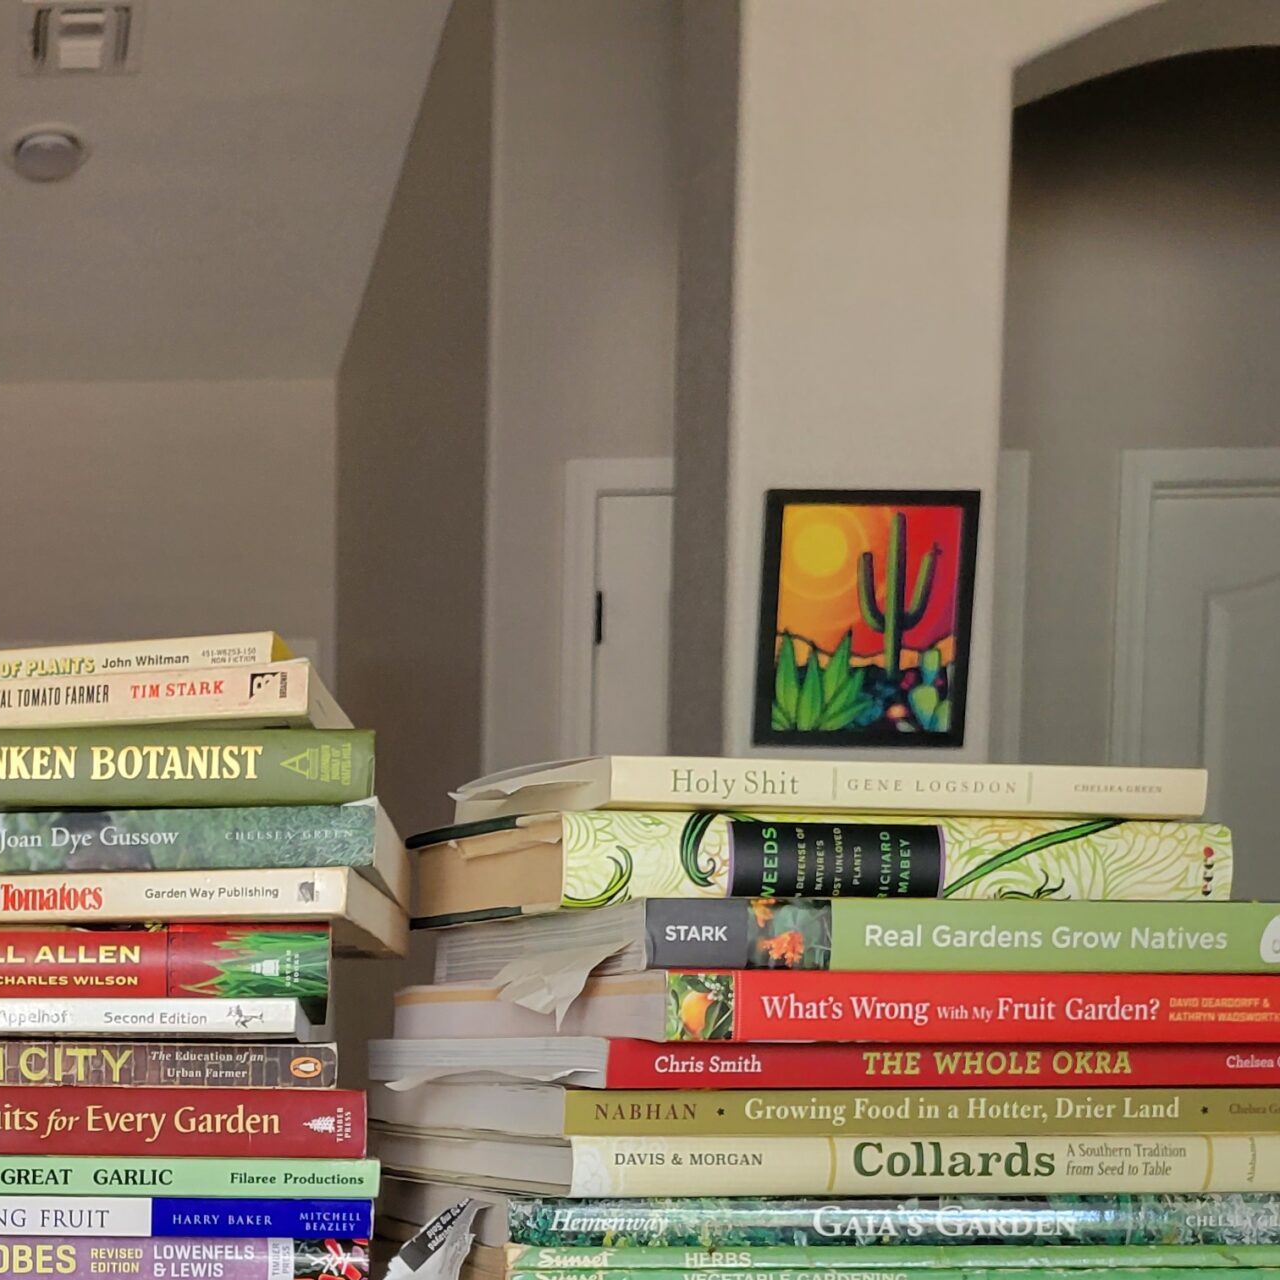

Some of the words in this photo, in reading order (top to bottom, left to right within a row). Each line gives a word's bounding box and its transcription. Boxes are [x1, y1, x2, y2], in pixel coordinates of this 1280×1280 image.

[25, 655, 95, 676] PLANTS
[102, 656, 132, 669] John
[135, 653, 189, 667] Whitman
[17, 687, 62, 707] TOMATO
[65, 685, 109, 705] FARMER
[90, 745, 263, 780] BOTANIST
[670, 768, 736, 799] Holy
[743, 771, 799, 795] Shit
[854, 846, 862, 884] PLANTS
[900, 840, 910, 893] MABEY
[1, 882, 103, 911] Tomatoes
[145, 888, 187, 900] Garden
[190, 888, 215, 902] Way
[218, 886, 279, 902] Publishing
[665, 926, 728, 941] STARK
[865, 926, 921, 947] Real
[932, 926, 1042, 947] Gardens
[1052, 928, 1121, 947] Grow
[1131, 927, 1228, 949] Natives
[104, 1012, 154, 1023] Second
[159, 1012, 207, 1024] Edition
[762, 996, 843, 1019] What's
[851, 999, 930, 1026] Wrong
[937, 1008, 968, 1019] With
[972, 1010, 993, 1022] My
[997, 999, 1055, 1020] Fruit
[1065, 999, 1160, 1021] Garden?
[655, 1057, 704, 1073] Chris
[709, 1056, 762, 1073] Smith
[595, 1104, 697, 1120] NABHAN
[615, 1153, 665, 1166] DAVIS
[672, 1154, 682, 1165] &
[690, 1154, 762, 1166] MORGAN
[853, 1142, 1055, 1177] Collards
[0, 1169, 72, 1184] GREAT
[93, 1169, 173, 1185] GARLIC
[230, 1173, 276, 1184] Filaree
[283, 1173, 364, 1185] Productions
[172, 1213, 220, 1225] HARRY
[228, 1215, 272, 1225] BAKER
[299, 1212, 361, 1221] MITCHELL
[305, 1222, 356, 1231] BEAZLEY
[154, 1245, 254, 1259] LOWENFELS
[154, 1264, 166, 1277] &
[171, 1263, 223, 1277] LEWIS
